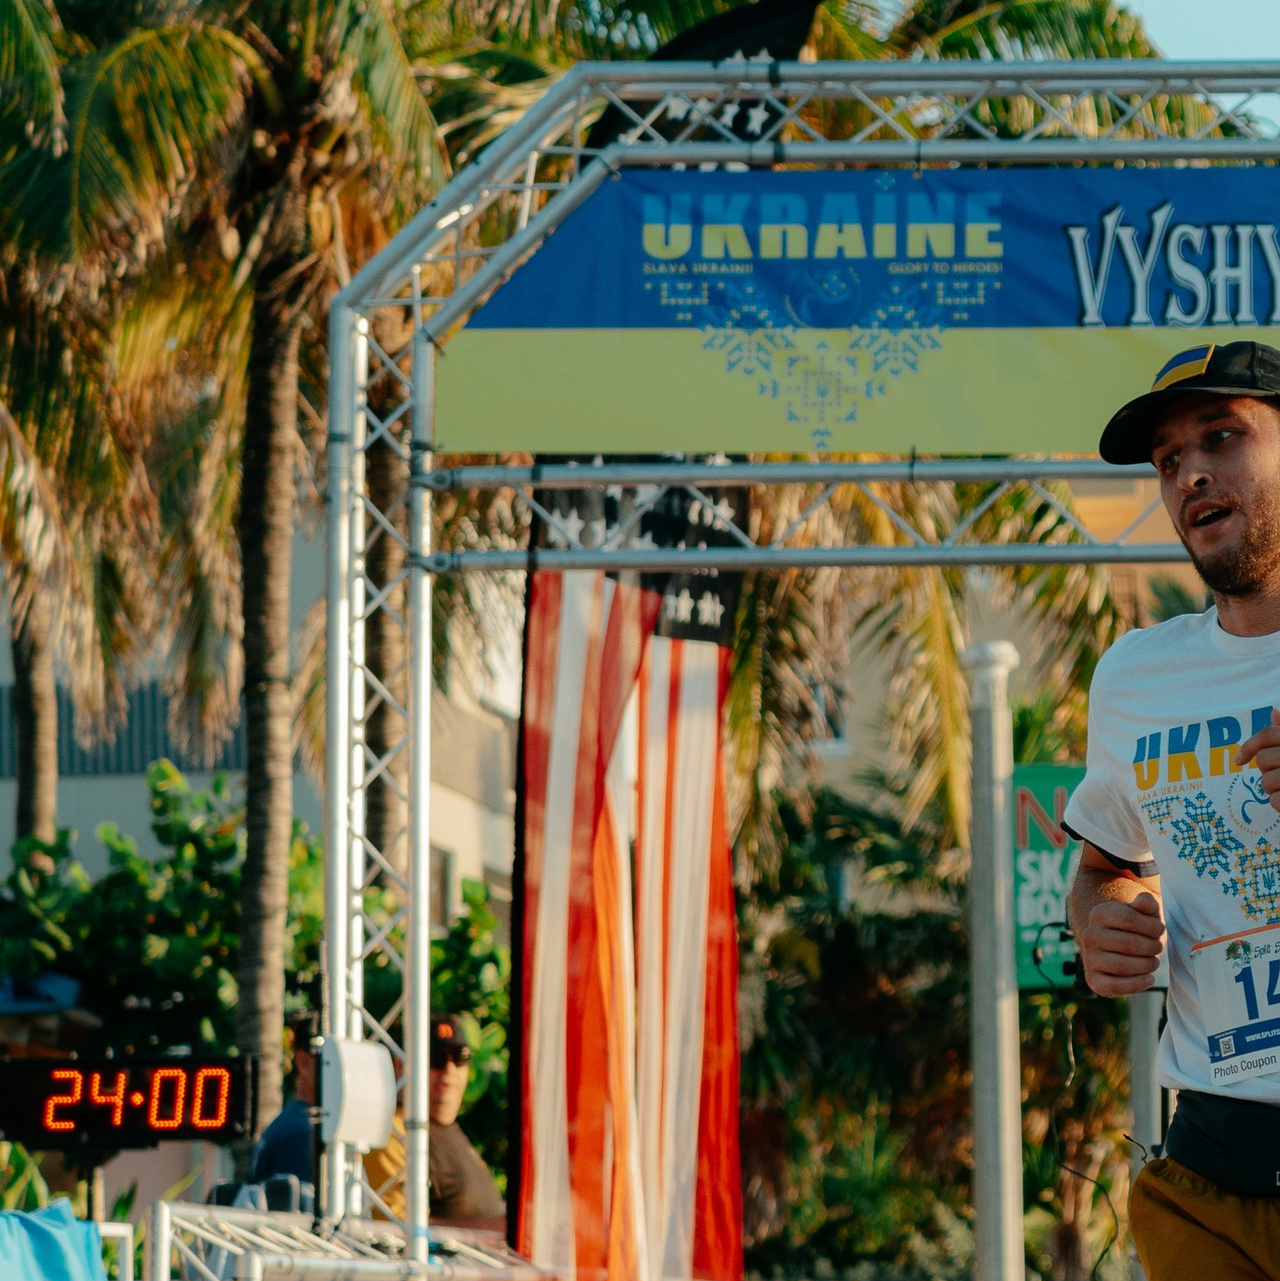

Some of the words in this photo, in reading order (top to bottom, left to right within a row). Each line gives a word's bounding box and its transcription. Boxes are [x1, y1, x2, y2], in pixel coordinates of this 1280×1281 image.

[643, 192, 1003, 258] UKRAINE
[643, 262, 688, 274] SLAVA
[888, 262, 929, 274] GLORY
[933, 262, 950, 274] TO
[1016, 786, 1069, 850] N
[1254, 943, 1272, 959] Split
[1214, 1063, 1239, 1079] Photo
[1240, 1054, 1277, 1071] Coupon
